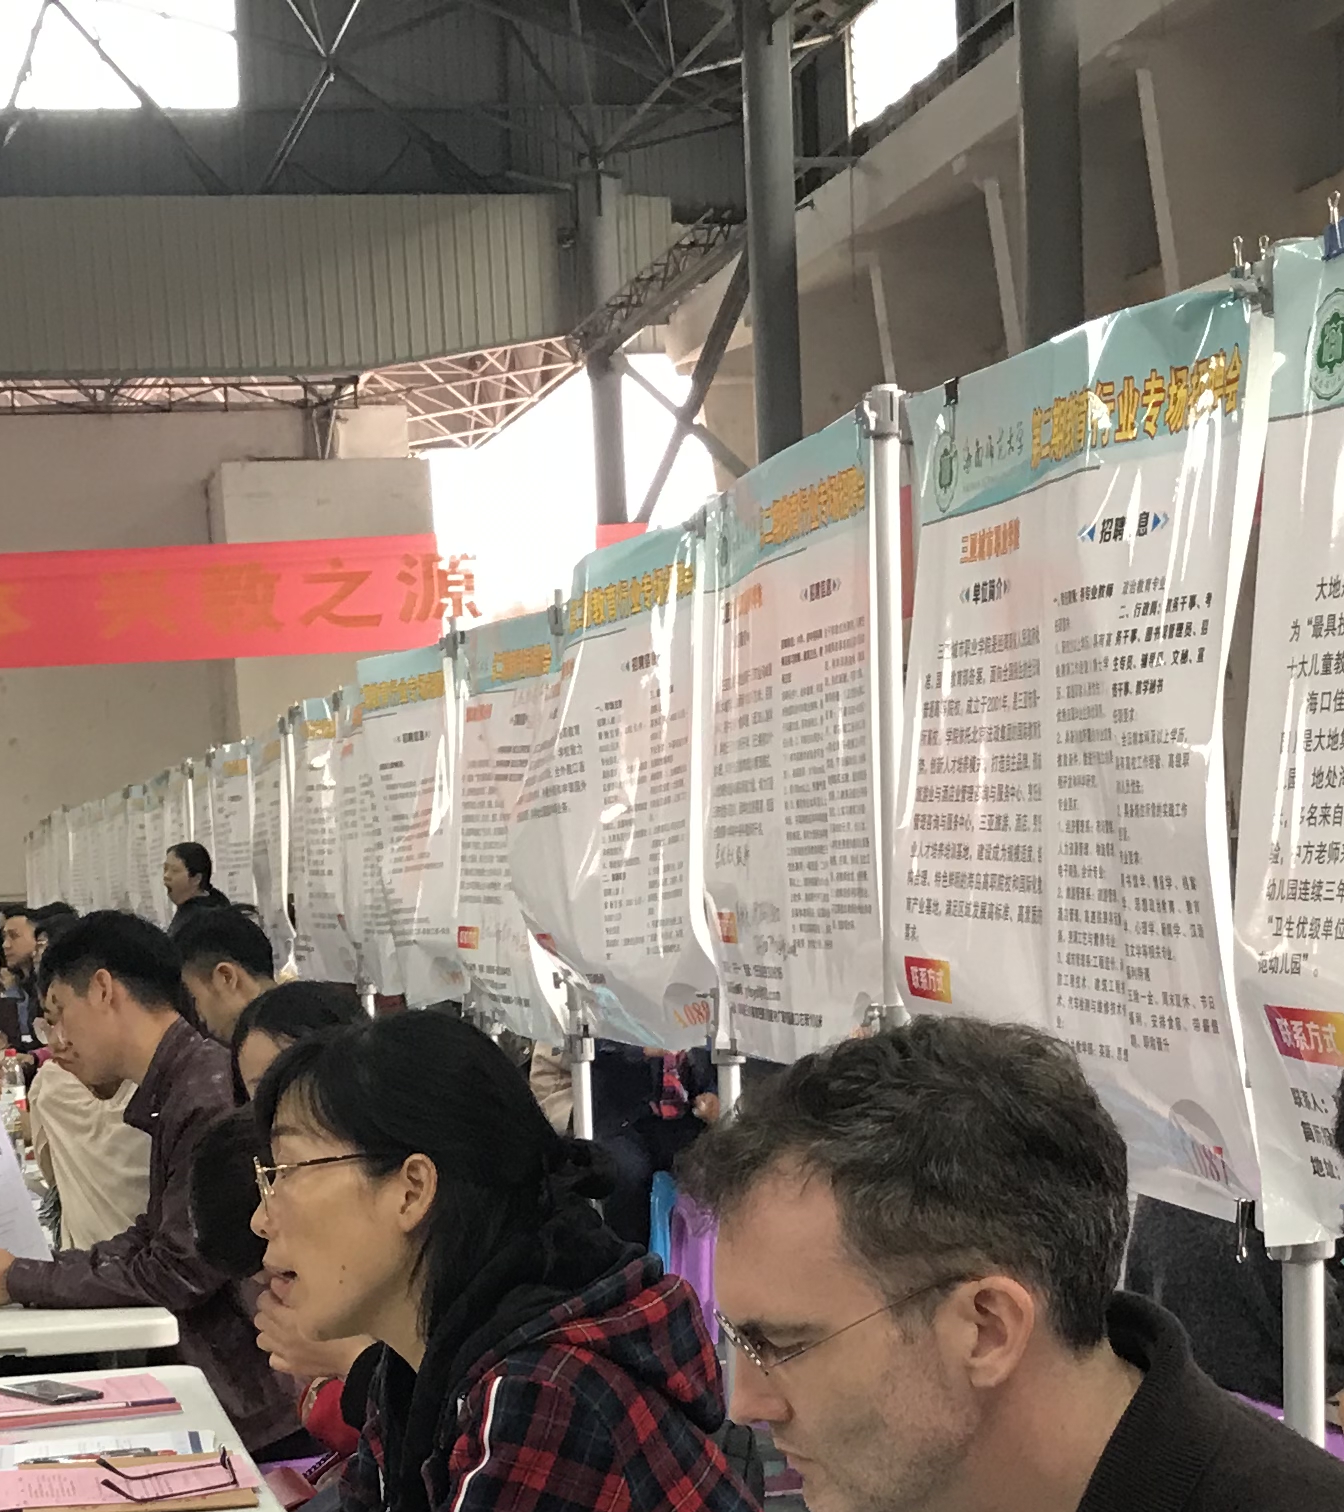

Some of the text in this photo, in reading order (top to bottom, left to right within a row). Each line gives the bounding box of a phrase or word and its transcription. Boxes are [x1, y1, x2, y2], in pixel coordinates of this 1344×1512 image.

[1098, 511, 1150, 545] 招聘息
[910, 965, 946, 993] 联系方式
[1275, 1016, 1342, 1056] 联系方式
